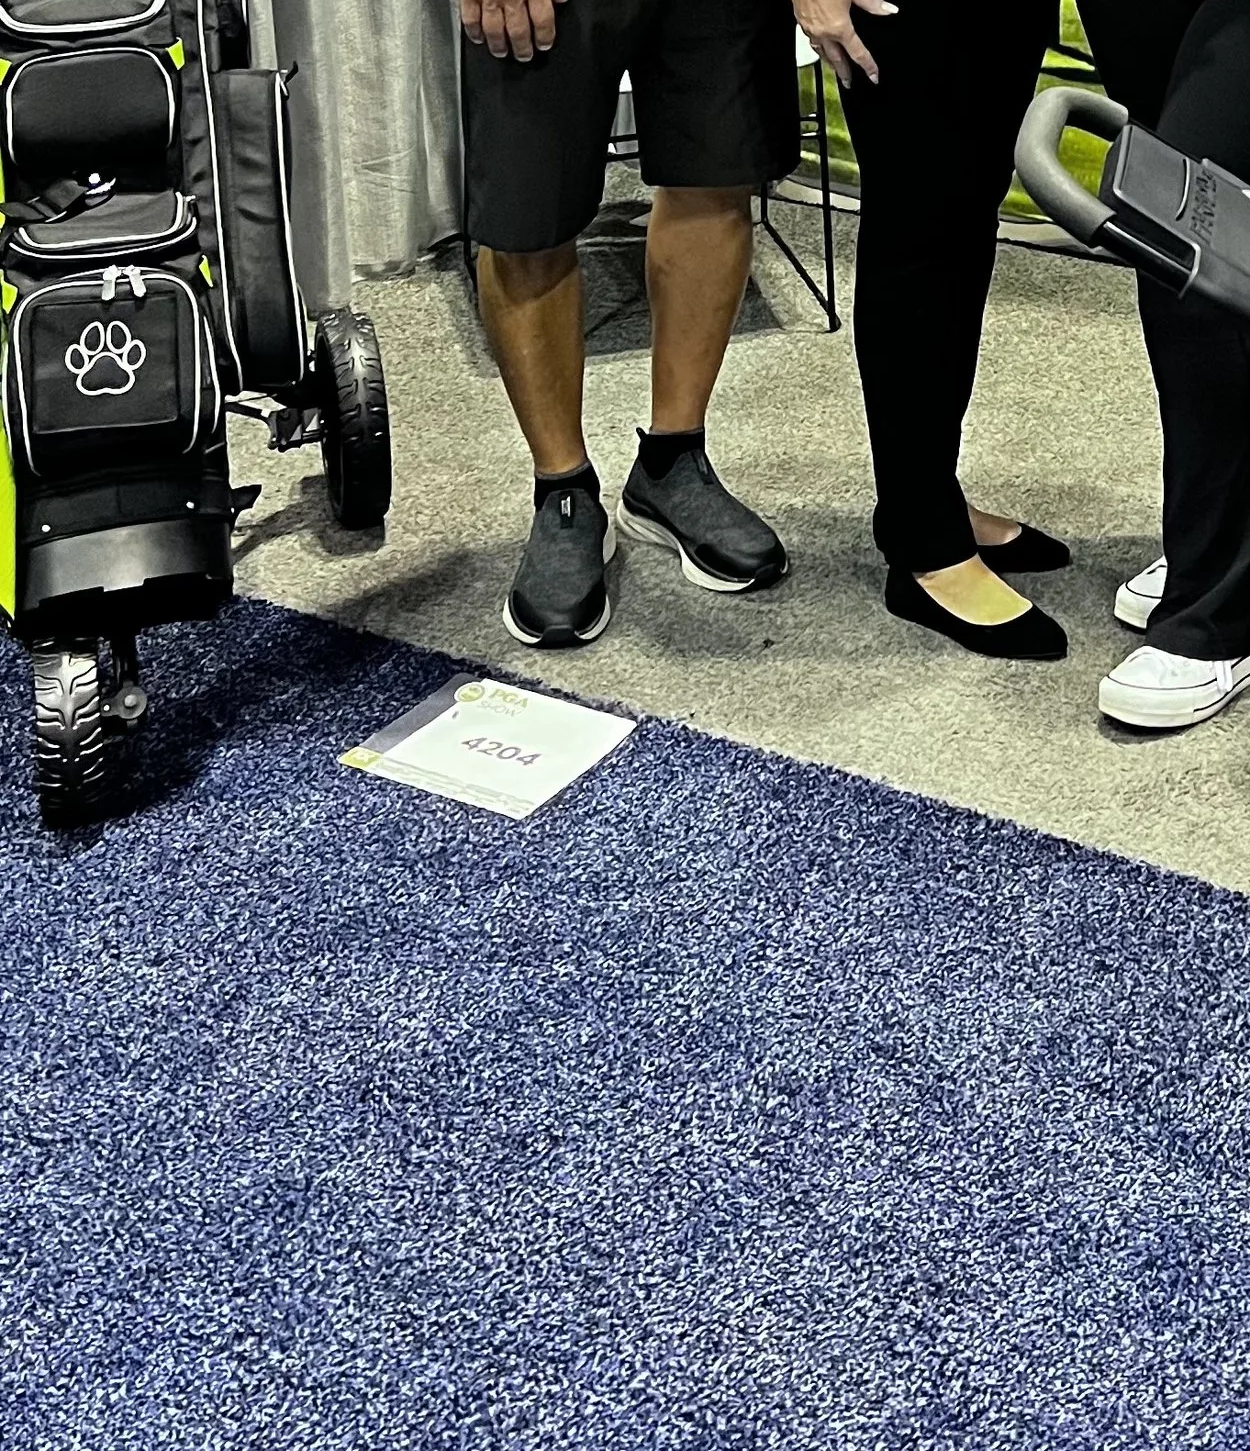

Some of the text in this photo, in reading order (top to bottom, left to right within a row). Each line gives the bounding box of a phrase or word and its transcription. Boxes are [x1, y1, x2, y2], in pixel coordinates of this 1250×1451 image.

[477, 699, 523, 717] SHOW
[490, 688, 528, 709] PGA
[461, 737, 543, 766] 4204
